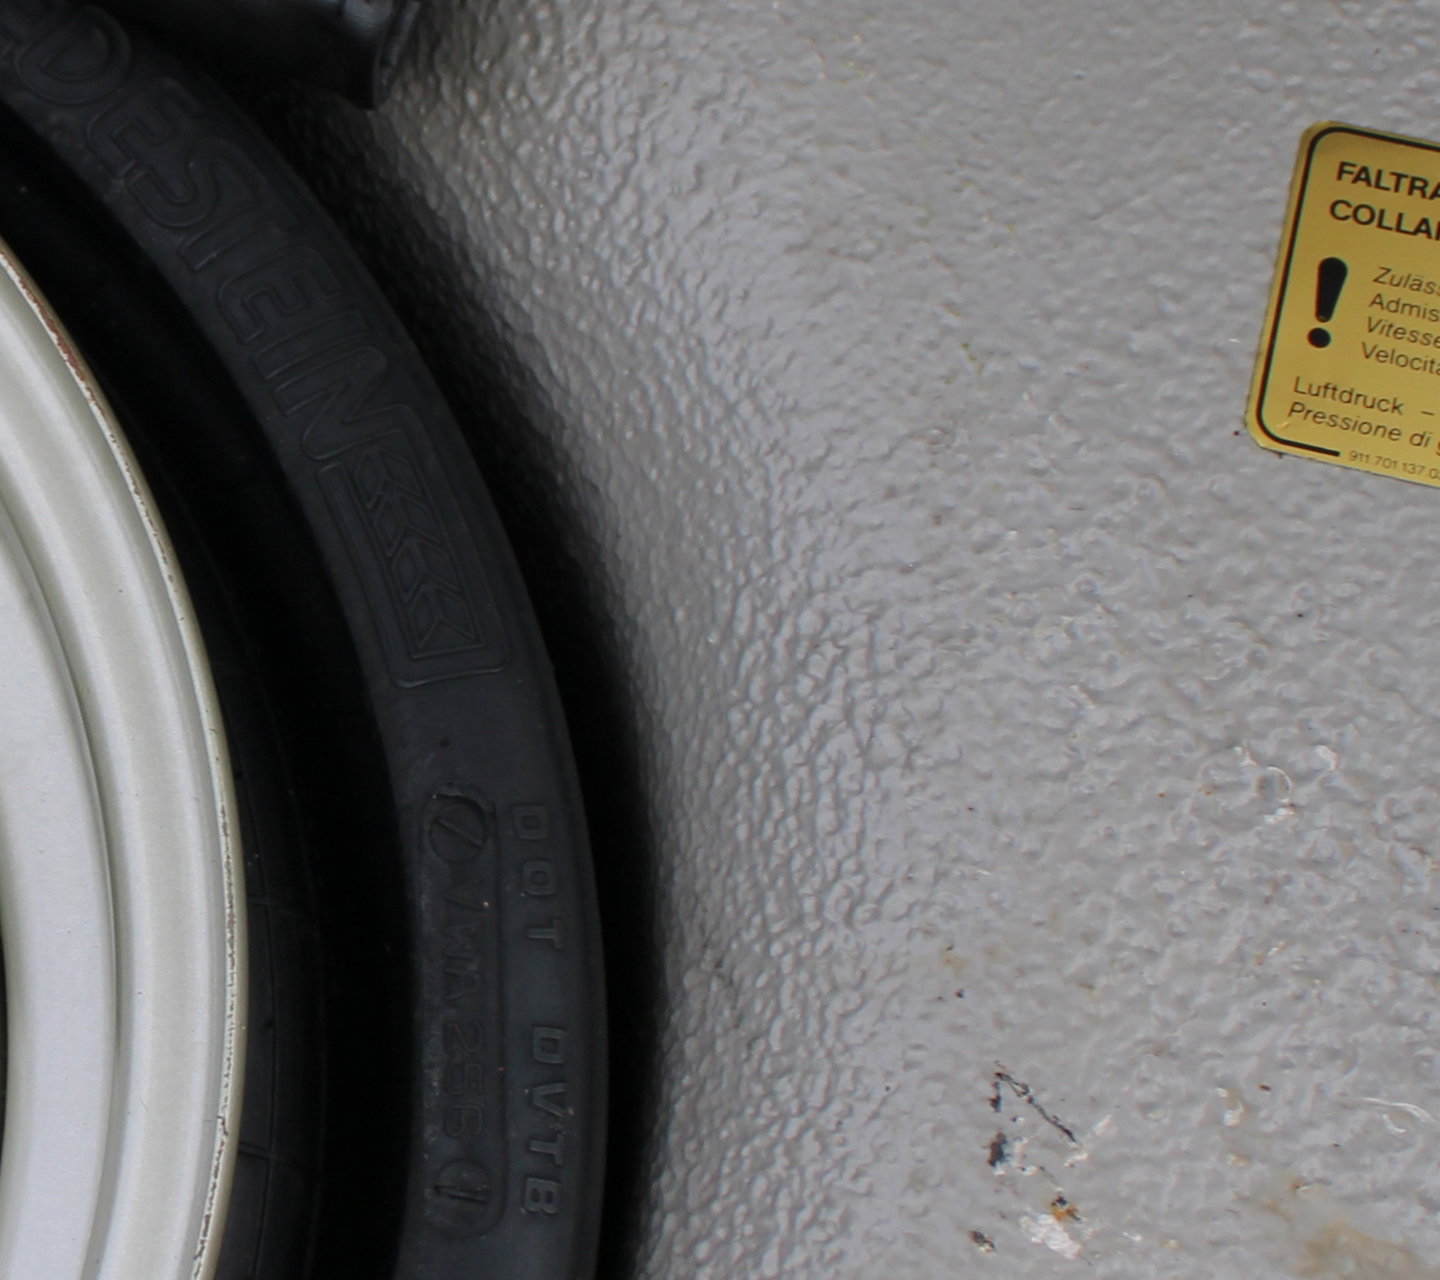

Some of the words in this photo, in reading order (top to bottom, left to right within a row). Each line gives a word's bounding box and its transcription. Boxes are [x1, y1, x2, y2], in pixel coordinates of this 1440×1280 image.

[1293, 375, 1404, 416] Luftdruck
[1287, 401, 1402, 442] Pressione
[1409, 431, 1432, 448] di
[506, 799, 566, 953] DOT
